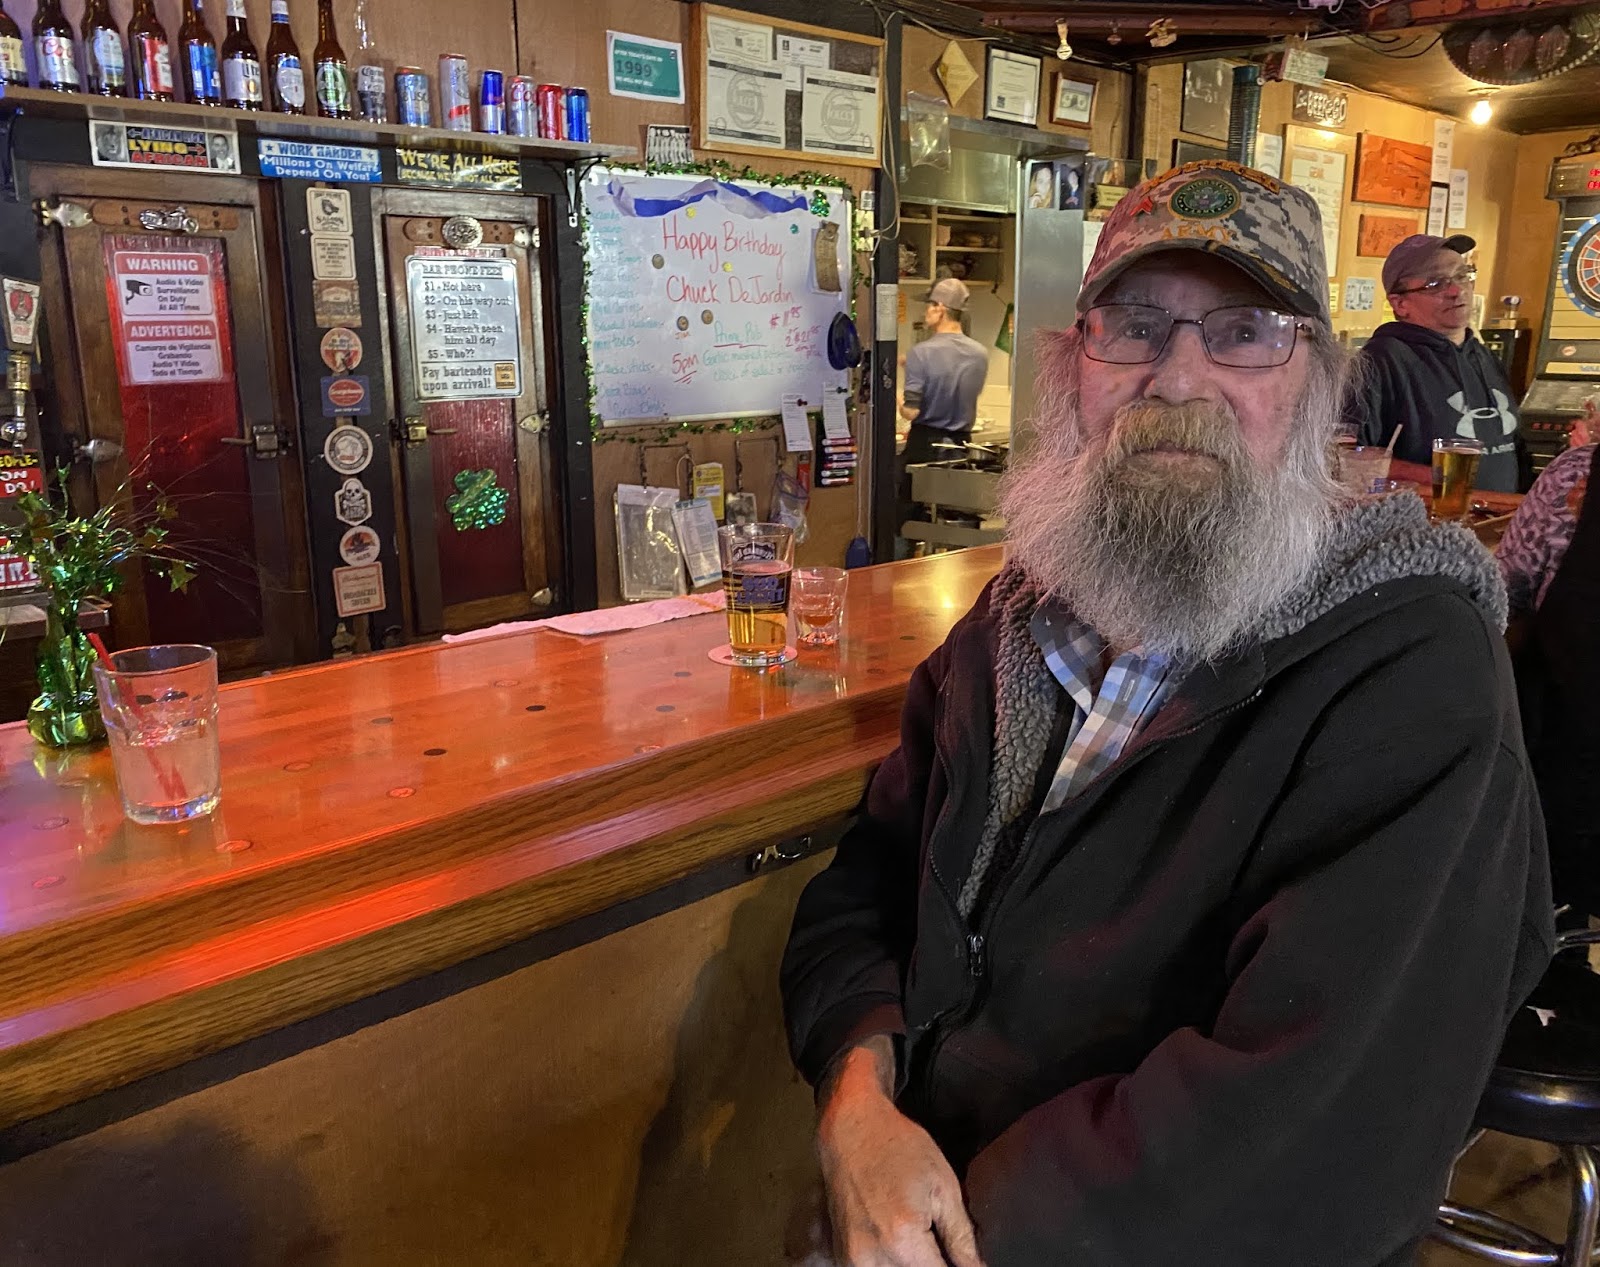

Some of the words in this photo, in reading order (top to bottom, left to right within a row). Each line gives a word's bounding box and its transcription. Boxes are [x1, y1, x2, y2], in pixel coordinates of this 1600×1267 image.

[616, 60, 652, 77] 1999
[128, 139, 188, 154] LYING
[278, 143, 313, 155] WORK
[316, 146, 362, 160] HARDER
[131, 151, 208, 167] AFRICAN
[264, 157, 311, 168] Millions
[315, 160, 333, 169] On
[337, 161, 379, 172] Welfare
[401, 149, 450, 170] WE'RE
[275, 166, 320, 178] Depend
[323, 170, 341, 179] On
[344, 171, 371, 181] You!
[1160, 223, 1231, 244] ARMY
[662, 214, 718, 273] Happy
[723, 221, 787, 282] Birthday
[126, 258, 199, 271] WARNING
[422, 264, 442, 274] BAR
[185, 278, 203, 286] Video
[424, 281, 434, 291] $1
[442, 281, 459, 291] Not
[461, 281, 482, 291] here
[666, 275, 720, 303] Chuck
[170, 295, 186, 304] Duty
[424, 295, 436, 305] $2
[443, 295, 457, 305] On
[459, 295, 473, 305] his
[474, 297, 494, 308] way
[496, 297, 510, 306] out
[425, 309, 436, 319] $3
[443, 309, 461, 321] Just
[463, 309, 479, 319] left
[131, 325, 212, 337] ADVERTENCIA
[426, 323, 437, 333] $4
[444, 323, 479, 333] Haven't
[482, 325, 504, 333] seen
[445, 336, 464, 344] him
[465, 335, 477, 344] all
[479, 335, 497, 346] day
[428, 349, 438, 358] $5
[446, 348, 475, 358] Who??
[180, 360, 200, 368] Video
[672, 353, 699, 375] 5pm
[178, 368, 203, 376] Tiempo
[422, 366, 440, 379] Pay
[443, 366, 492, 377] bartender
[422, 381, 448, 393] upon
[452, 377, 491, 389] arrival!
